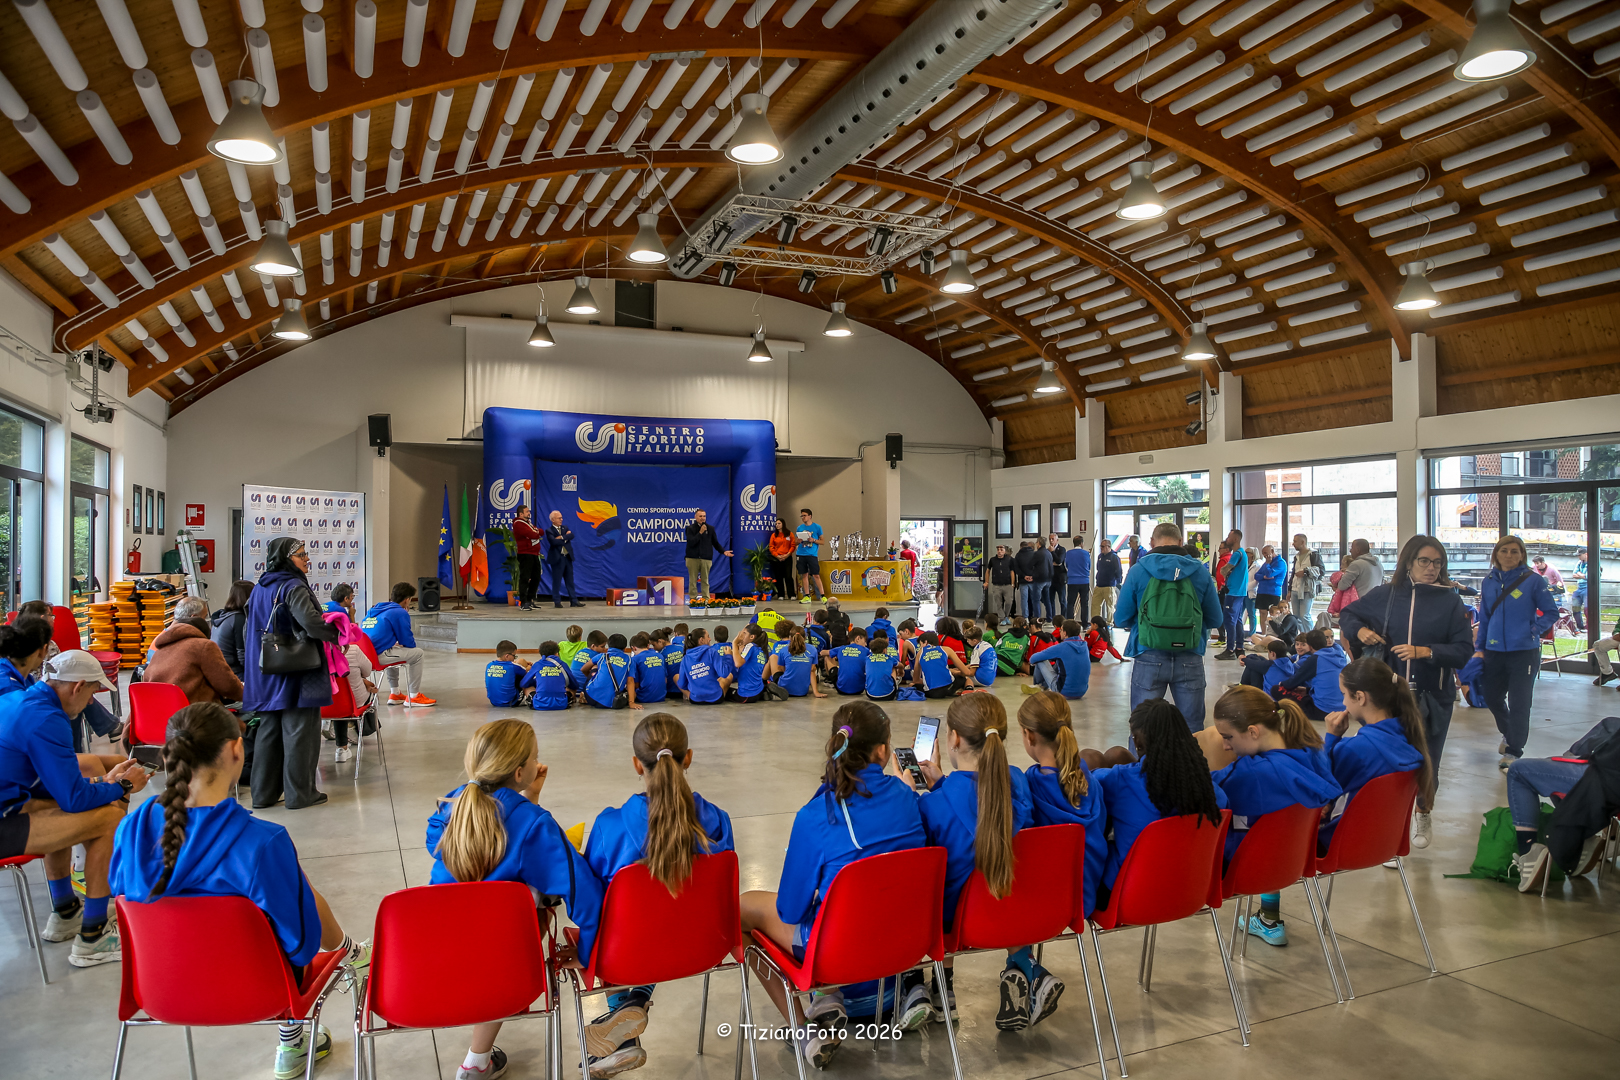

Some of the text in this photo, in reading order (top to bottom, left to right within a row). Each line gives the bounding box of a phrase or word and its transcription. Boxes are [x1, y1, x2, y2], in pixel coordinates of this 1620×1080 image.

[627, 426, 704, 436] CENTRO
[628, 434, 704, 444] SPORTIVO
[627, 444, 704, 453] ITALIANO
[627, 518, 696, 530] CAMPIONAT
[627, 532, 688, 543] NAZIONAL
[622, 591, 638, 604] 2
[653, 580, 672, 604] 1
